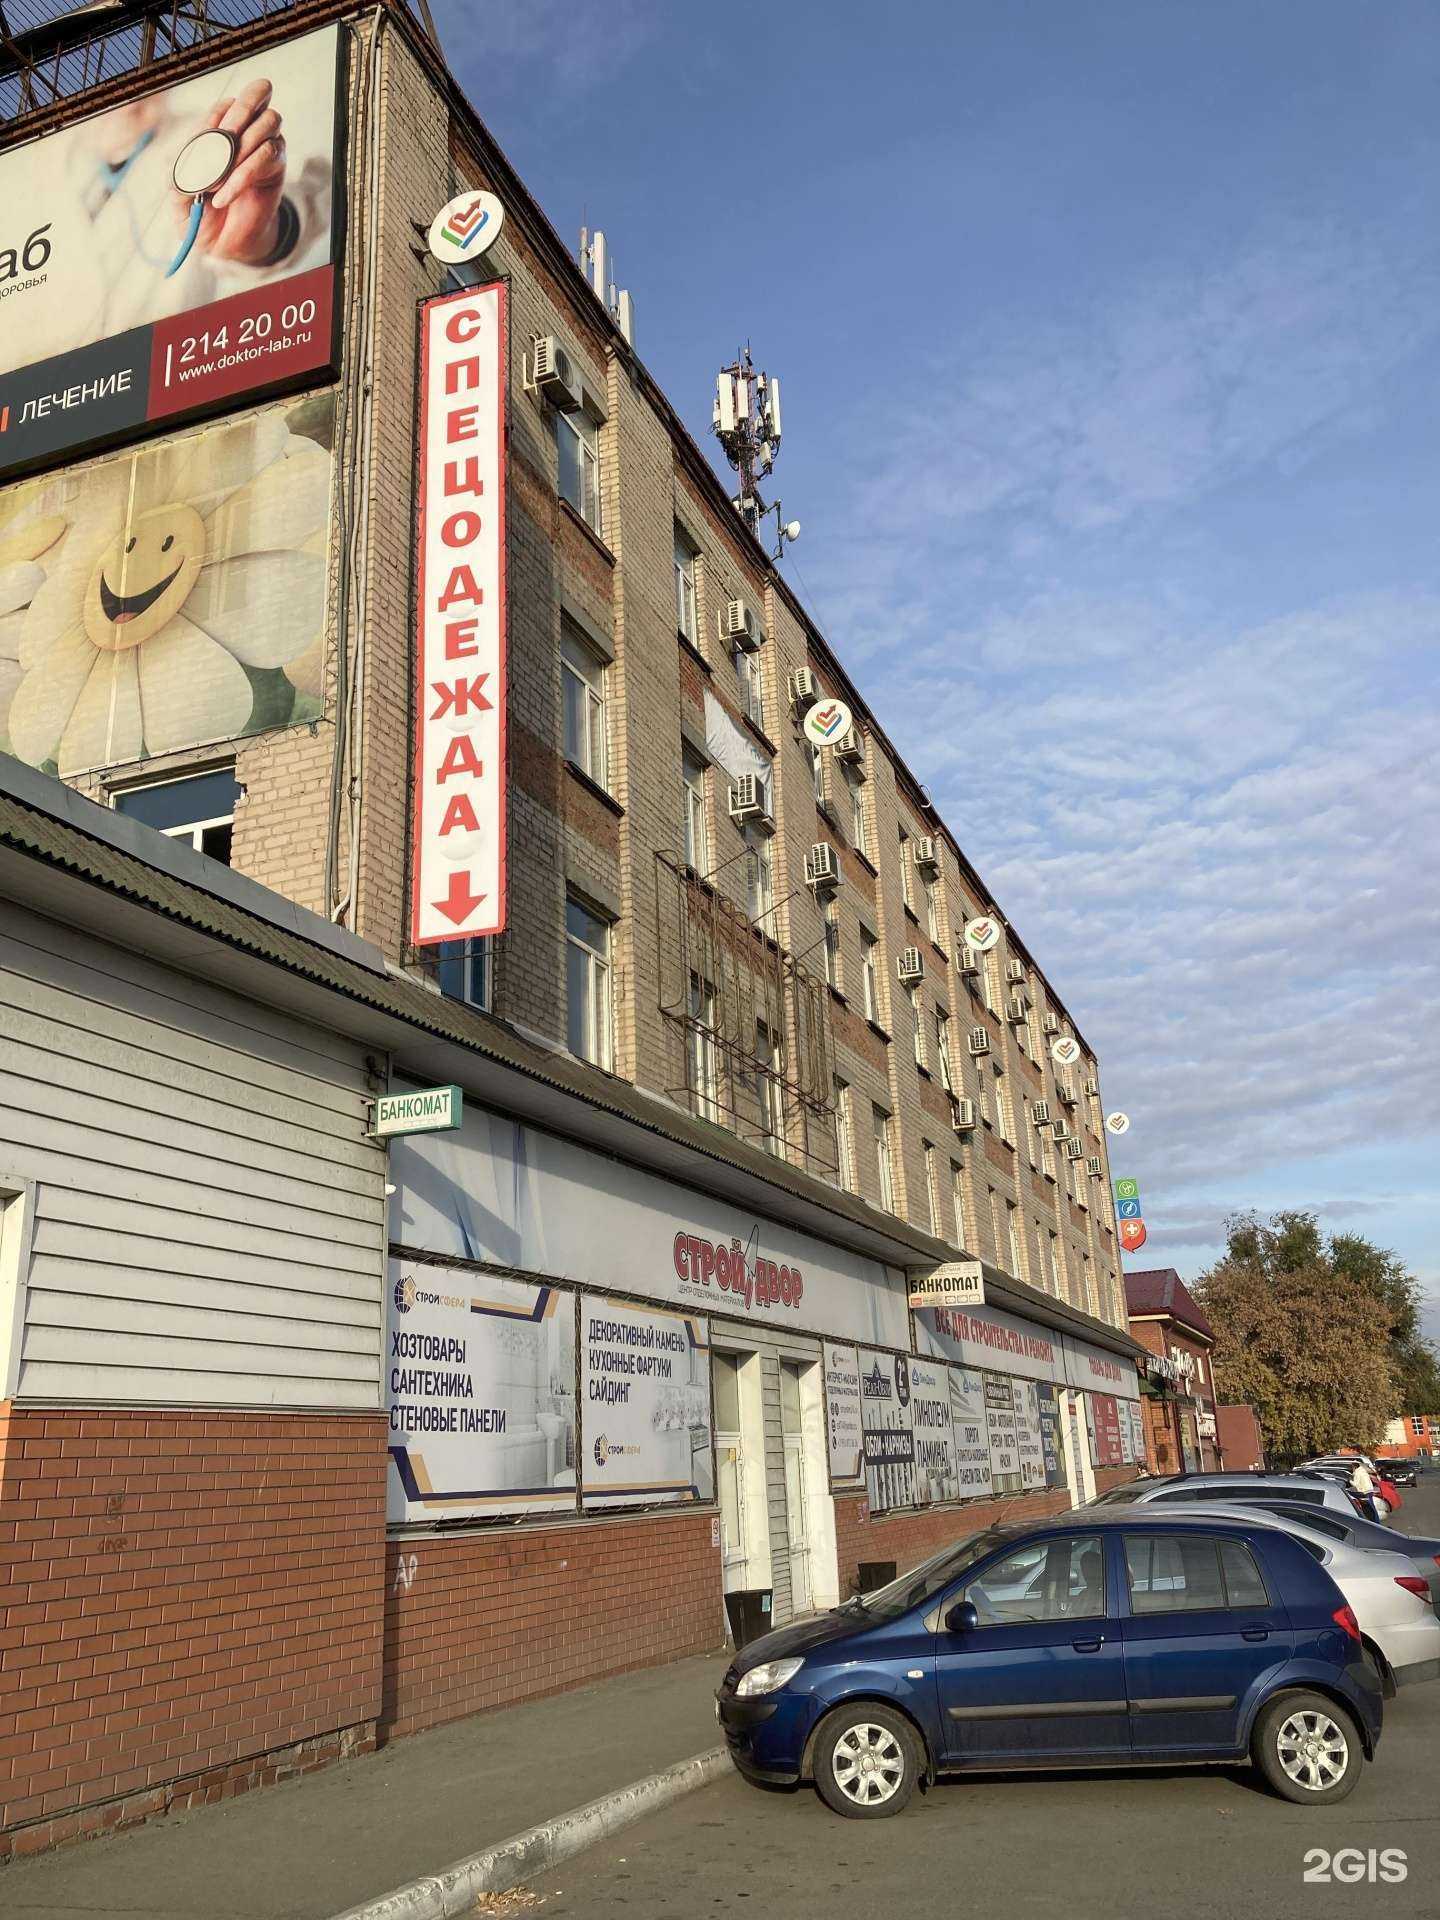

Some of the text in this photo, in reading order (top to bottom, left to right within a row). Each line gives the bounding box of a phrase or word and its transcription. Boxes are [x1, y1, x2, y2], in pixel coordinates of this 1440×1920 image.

[179, 299, 316, 363] 214 20 00
[178, 330, 312, 383] www.doktor-lab.ru
[18, 368, 133, 424] ЛЕЧЕНИЕ
[429, 308, 494, 837] СПЕЦОДЕЖДА
[380, 1094, 449, 1121] БАНКОМАТ
[910, 1275, 979, 1294] БАНКОМАТ
[391, 1331, 466, 1364] ХОЗТОВАРЫ
[589, 1319, 685, 1353] ДЕКОРАТИВНЫЙ КАМЕНЬ
[952, 1311, 970, 1343] ДЛЯ
[970, 1317, 1024, 1356] СТРОИТЕЛЬСТВА
[589, 1349, 672, 1378] КУХОННЫЕ ФАРТУКИ
[391, 1367, 474, 1398] САНТЕХНИКА
[589, 1375, 631, 1405] САЙДИНГ
[390, 1404, 506, 1433] СТЕНОВЫЕ ПАНЕЛИ
[914, 1398, 951, 1428] ЛИНОЛЕУМ
[916, 1439, 949, 1468] ЛАМИНАТ
